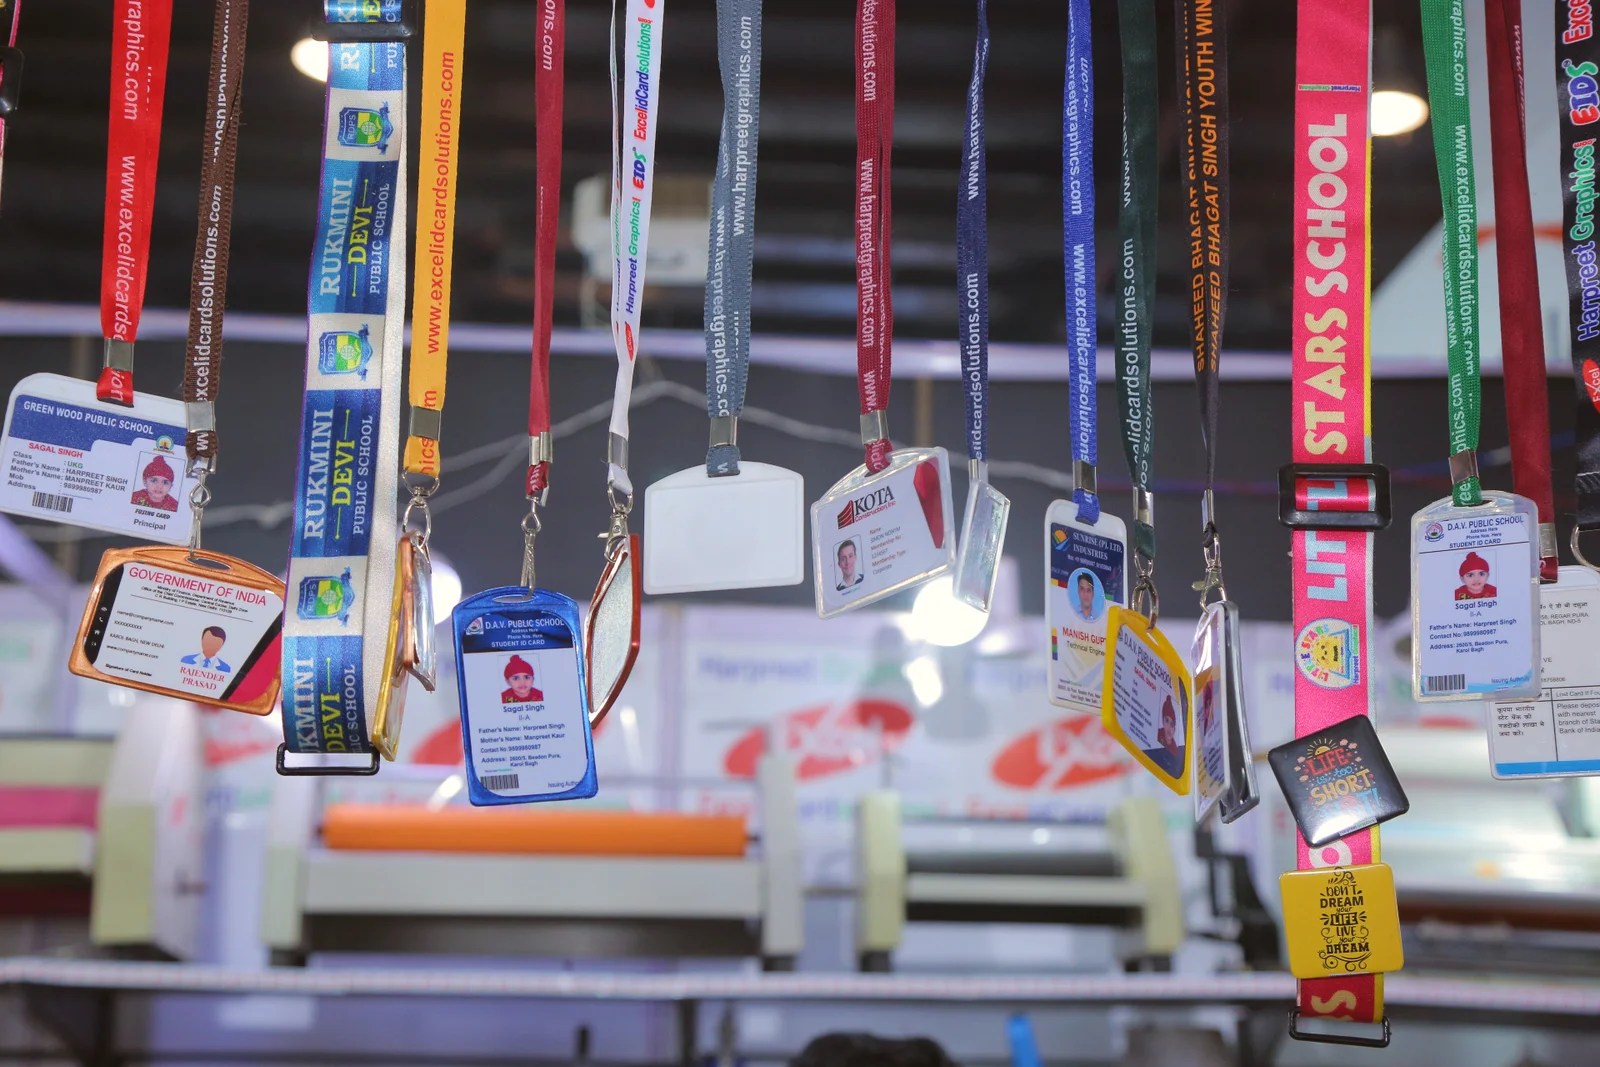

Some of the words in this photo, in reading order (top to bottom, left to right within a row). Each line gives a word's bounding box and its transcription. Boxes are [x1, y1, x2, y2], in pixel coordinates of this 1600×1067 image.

[1196, 42, 1216, 110] YOUTH
[732, 16, 753, 236] www.harpreetgraphics.com
[1200, 114, 1218, 177] SINGH
[373, 184, 390, 236] SCHOOL
[428, 52, 454, 354] www.excelidcardsolutions.com
[1305, 113, 1348, 297] SCHOOL
[347, 206, 373, 265] DEVI
[1204, 181, 1220, 266] BHAGAT
[320, 178, 353, 297] RUKMINI
[857, 158, 877, 347] www.harpreetgraphics.com
[370, 240, 383, 294] PUBLIC
[626, 258, 638, 314] Harpreet
[1571, 240, 1600, 342] Harpreet
[1192, 273, 1205, 372] SHAHEED
[1209, 272, 1221, 373] SHAHEED
[1303, 307, 1348, 455] STARS
[24, 400, 54, 416] GREEN
[56, 407, 83, 421] WOOD
[85, 412, 116, 428] PUBLIC
[119, 419, 154, 435] SCHOOL
[13, 450, 32, 460] Class
[28, 442, 55, 454] SAGAL
[58, 447, 83, 459] SINGH
[358, 415, 373, 476] SCHOOL
[8, 480, 36, 490] Address
[9, 472, 24, 481] Mob
[10, 465, 40, 476] Mother's
[65, 475, 104, 488] MANPREET
[105, 483, 126, 492] KAUR
[12, 458, 39, 469] Father's
[41, 463, 60, 472] Name
[66, 468, 104, 480] HARPREET
[106, 475, 128, 485] SINGH
[304, 408, 334, 540] RUKMINI
[332, 440, 356, 507] DEVI
[353, 480, 368, 535] PUBLIC
[854, 486, 895, 516] KOTA
[133, 518, 166, 531] Principal
[1447, 523, 1467, 531] D.A.V.
[1469, 520, 1494, 528] PUBLIC
[1495, 515, 1524, 525] SCHOOL
[1073, 532, 1098, 547] SUNRISE
[1073, 543, 1108, 560] INDUSTRIES
[129, 567, 214, 593] GOVERNMENT
[216, 586, 233, 598] OF
[235, 590, 267, 606] INDIA
[1478, 600, 1497, 609] Singh
[485, 621, 506, 630] D.A.V.
[508, 619, 534, 629] PUBLIC
[535, 618, 565, 627] SCHOOL
[1062, 626, 1089, 642] MANISH
[1473, 620, 1498, 628] Harpreet
[491, 640, 519, 648] STUDENT
[1066, 640, 1088, 652] Technical
[180, 666, 225, 682] RAJENDER
[182, 677, 217, 690] PRASAD
[344, 664, 359, 734] SCHOOL
[525, 703, 545, 713] Singh
[321, 692, 346, 752] DEVI
[1558, 710, 1571, 718] with
[1558, 718, 1580, 726] branch
[523, 724, 548, 732] Harpreet
[1306, 748, 1350, 776] LIFE
[1334, 766, 1353, 778] too
[1311, 768, 1372, 806] SHORT
[1320, 896, 1364, 909] DREAM
[1332, 913, 1358, 925] LIFE
[1336, 925, 1357, 937] LIVE
[1326, 942, 1370, 955] DREAM
